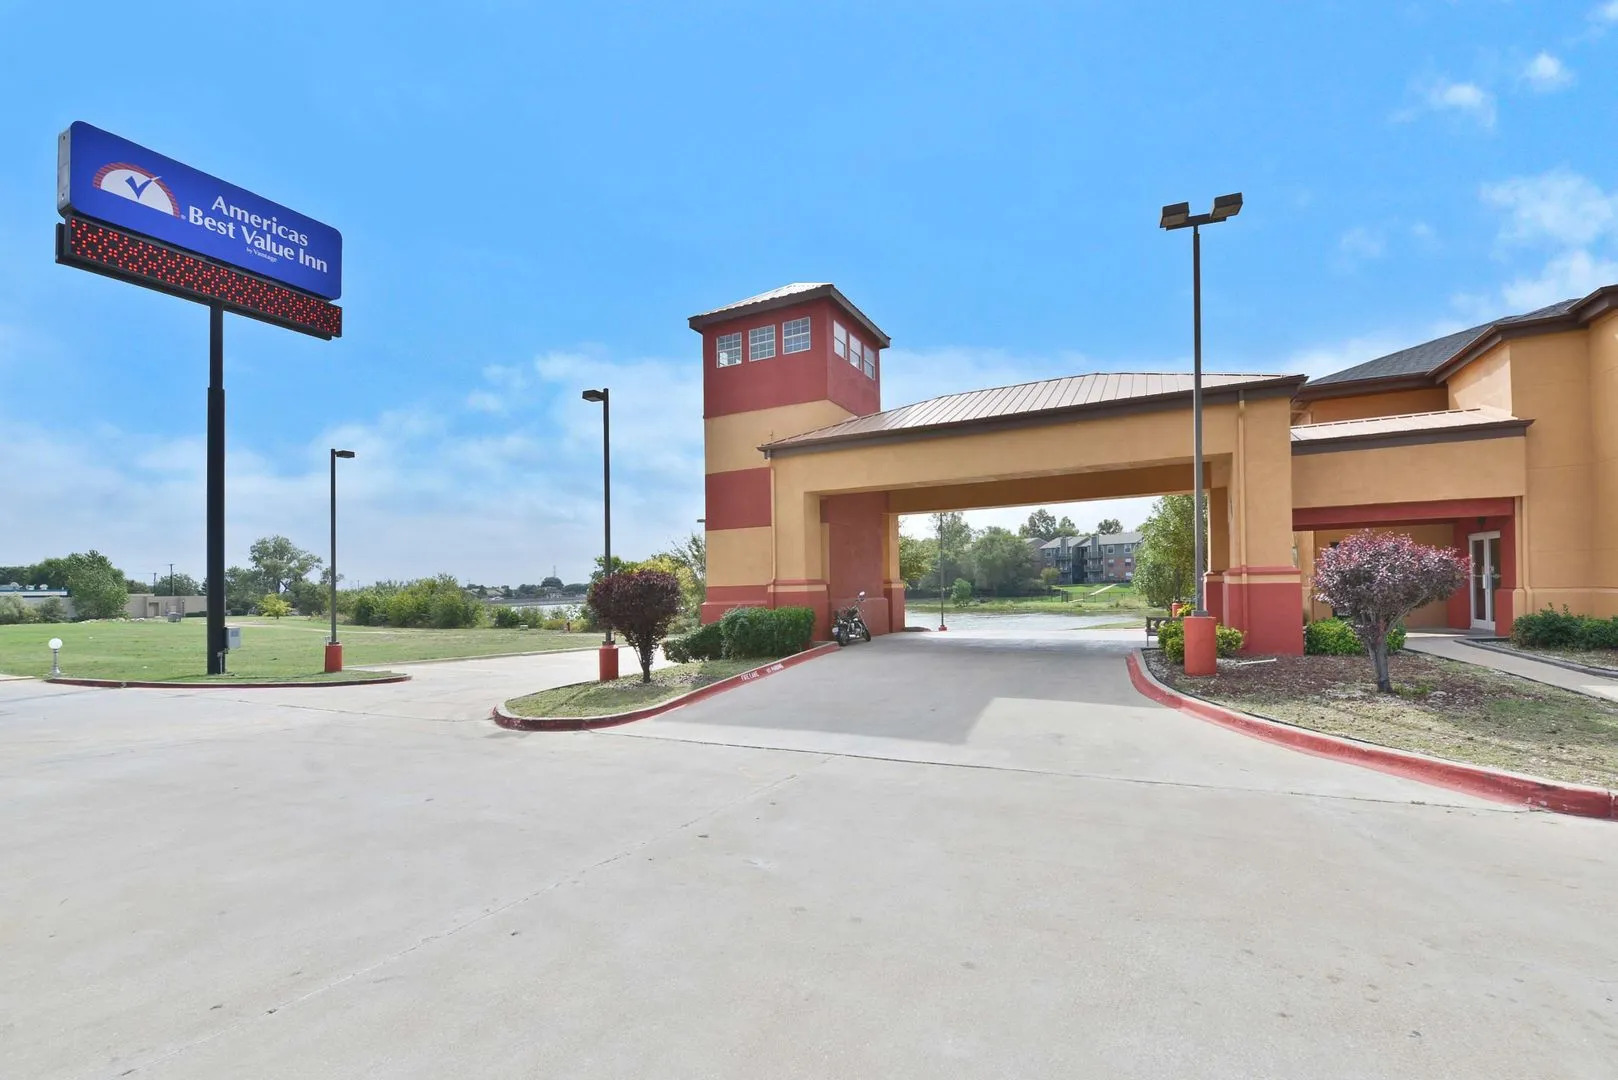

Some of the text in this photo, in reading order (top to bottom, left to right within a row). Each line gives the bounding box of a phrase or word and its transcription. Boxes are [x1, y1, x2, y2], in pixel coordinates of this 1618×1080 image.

[189, 205, 328, 273] Best Value Inn
[211, 195, 309, 247] Americas
